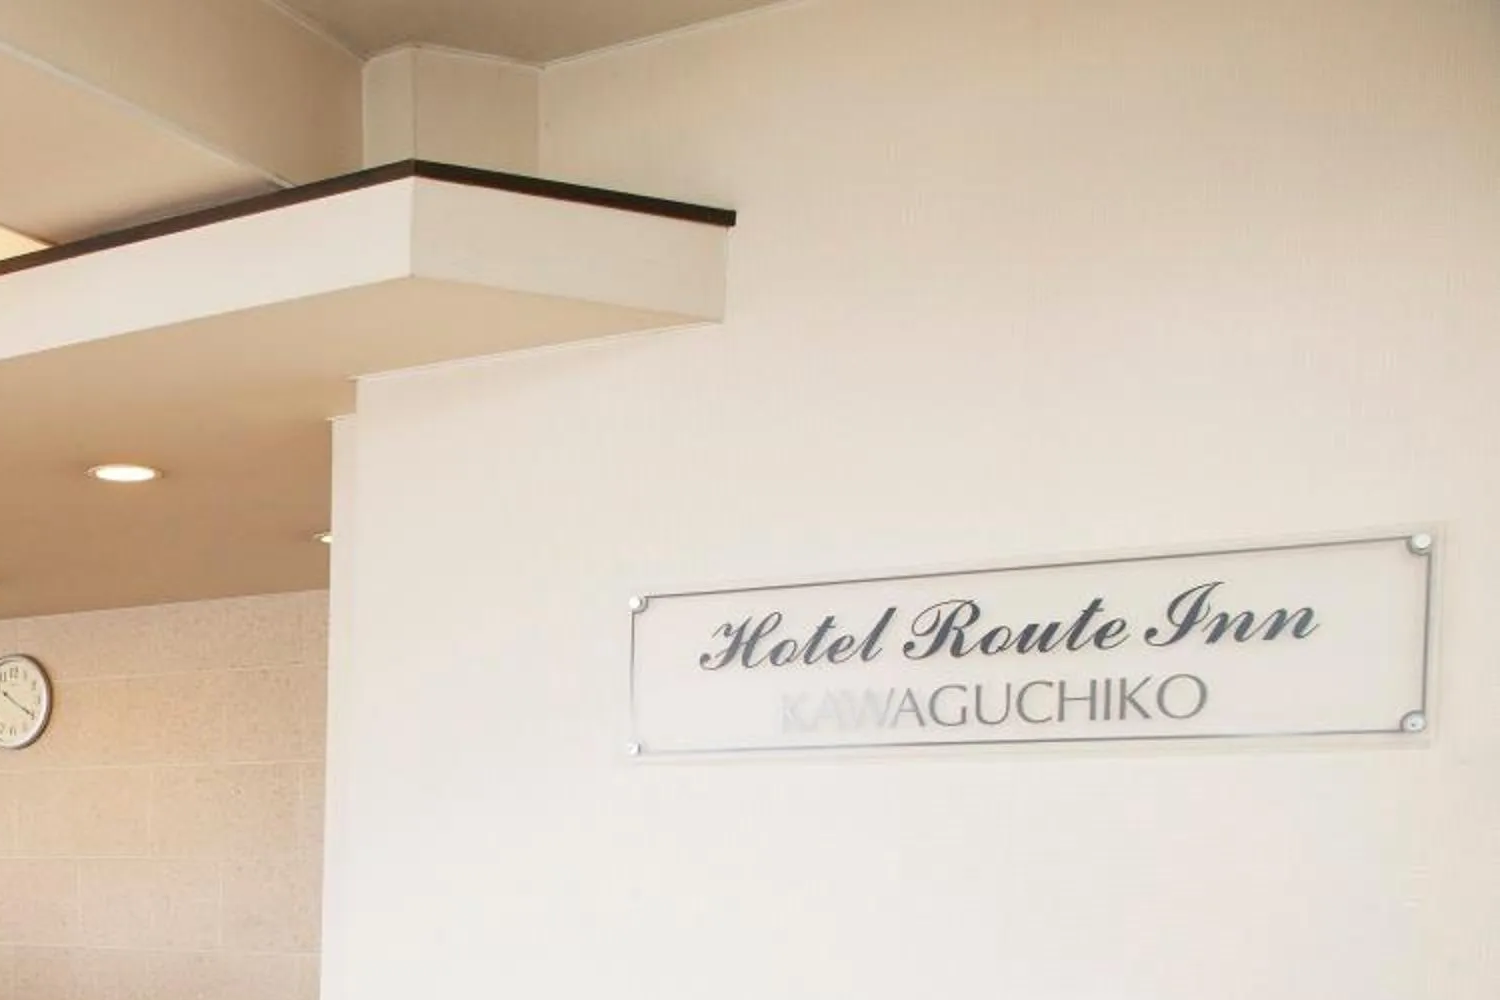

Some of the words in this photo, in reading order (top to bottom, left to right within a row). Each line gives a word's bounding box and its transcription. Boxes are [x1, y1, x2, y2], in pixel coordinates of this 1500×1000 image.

[699, 606, 897, 671] Hotel
[902, 597, 1130, 660] Route
[1143, 580, 1320, 648] Inn
